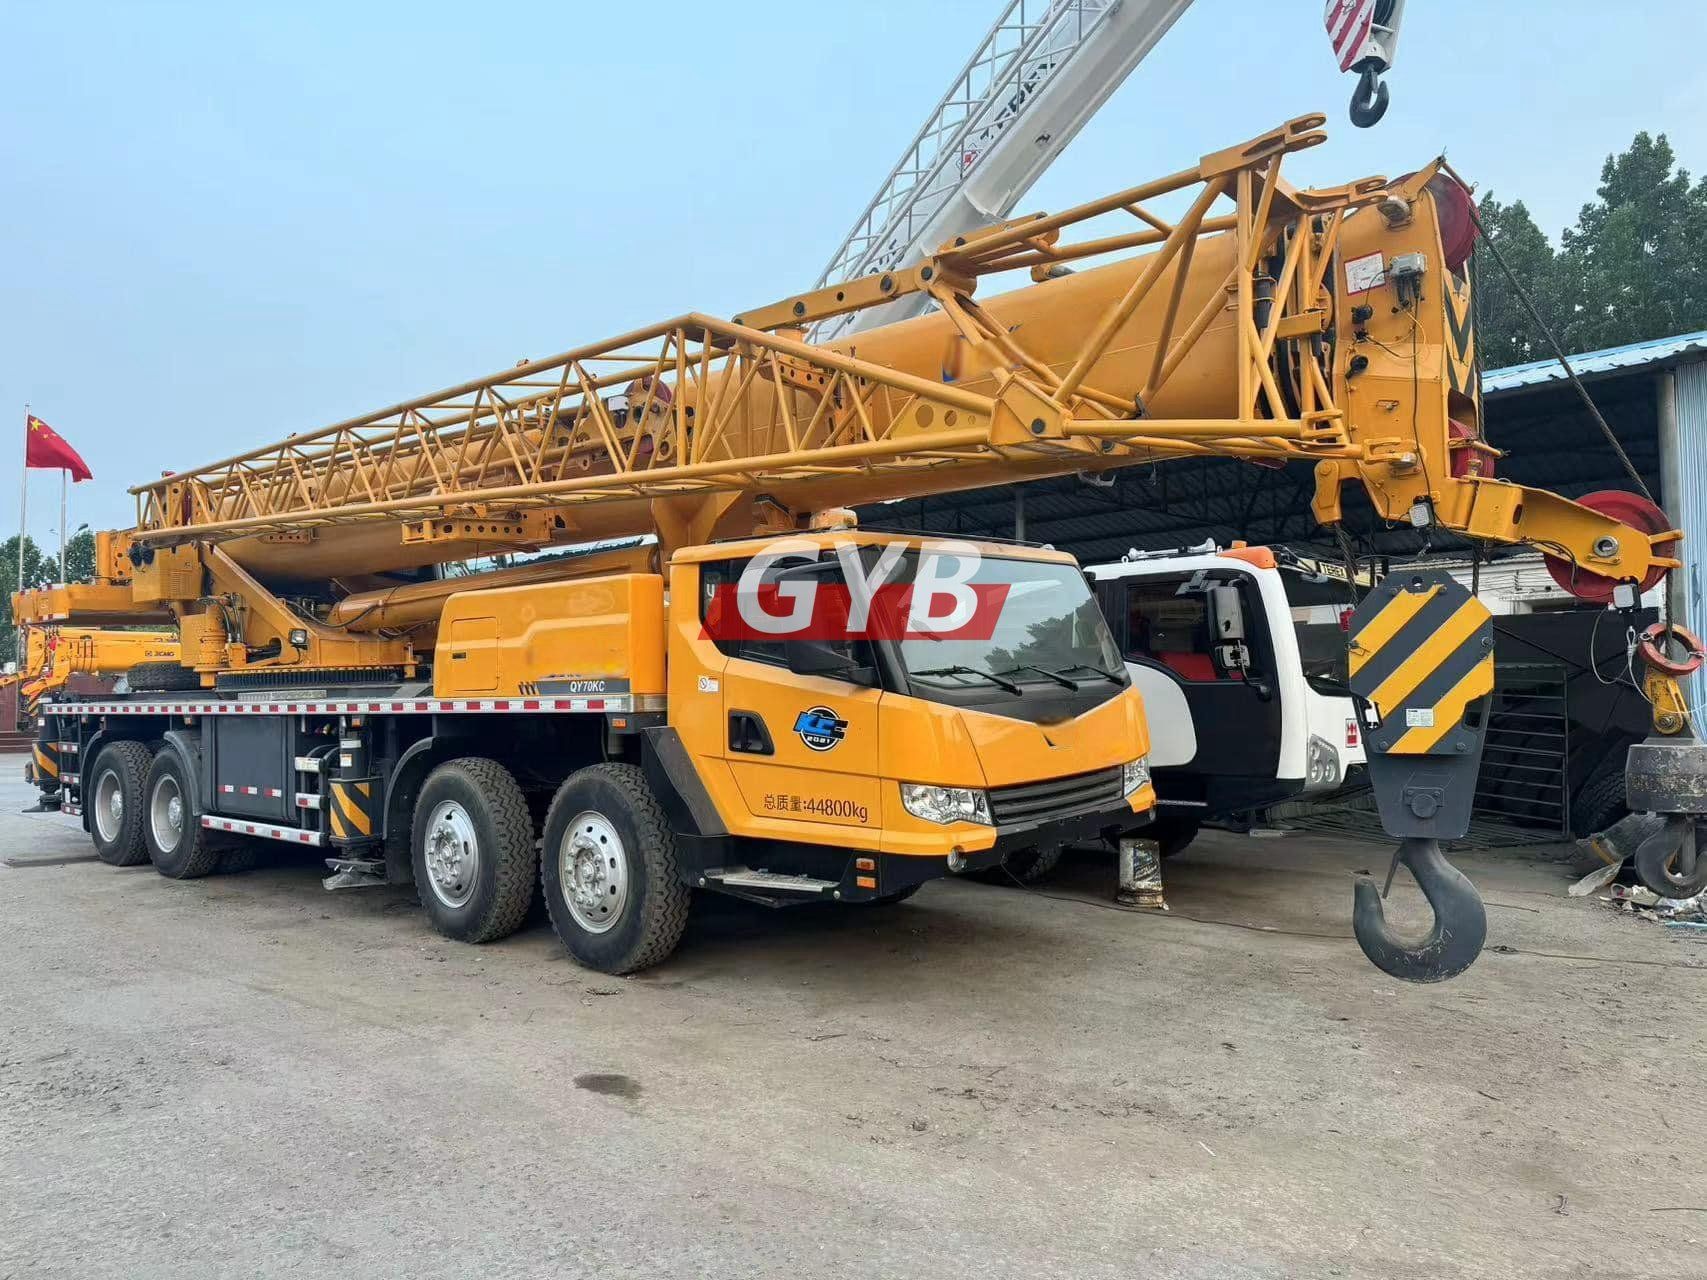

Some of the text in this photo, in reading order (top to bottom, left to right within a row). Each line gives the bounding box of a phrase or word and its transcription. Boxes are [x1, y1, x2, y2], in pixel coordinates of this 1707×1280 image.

[569, 680, 606, 692] QY70KC
[764, 793, 868, 823] 总质量:44800kg
